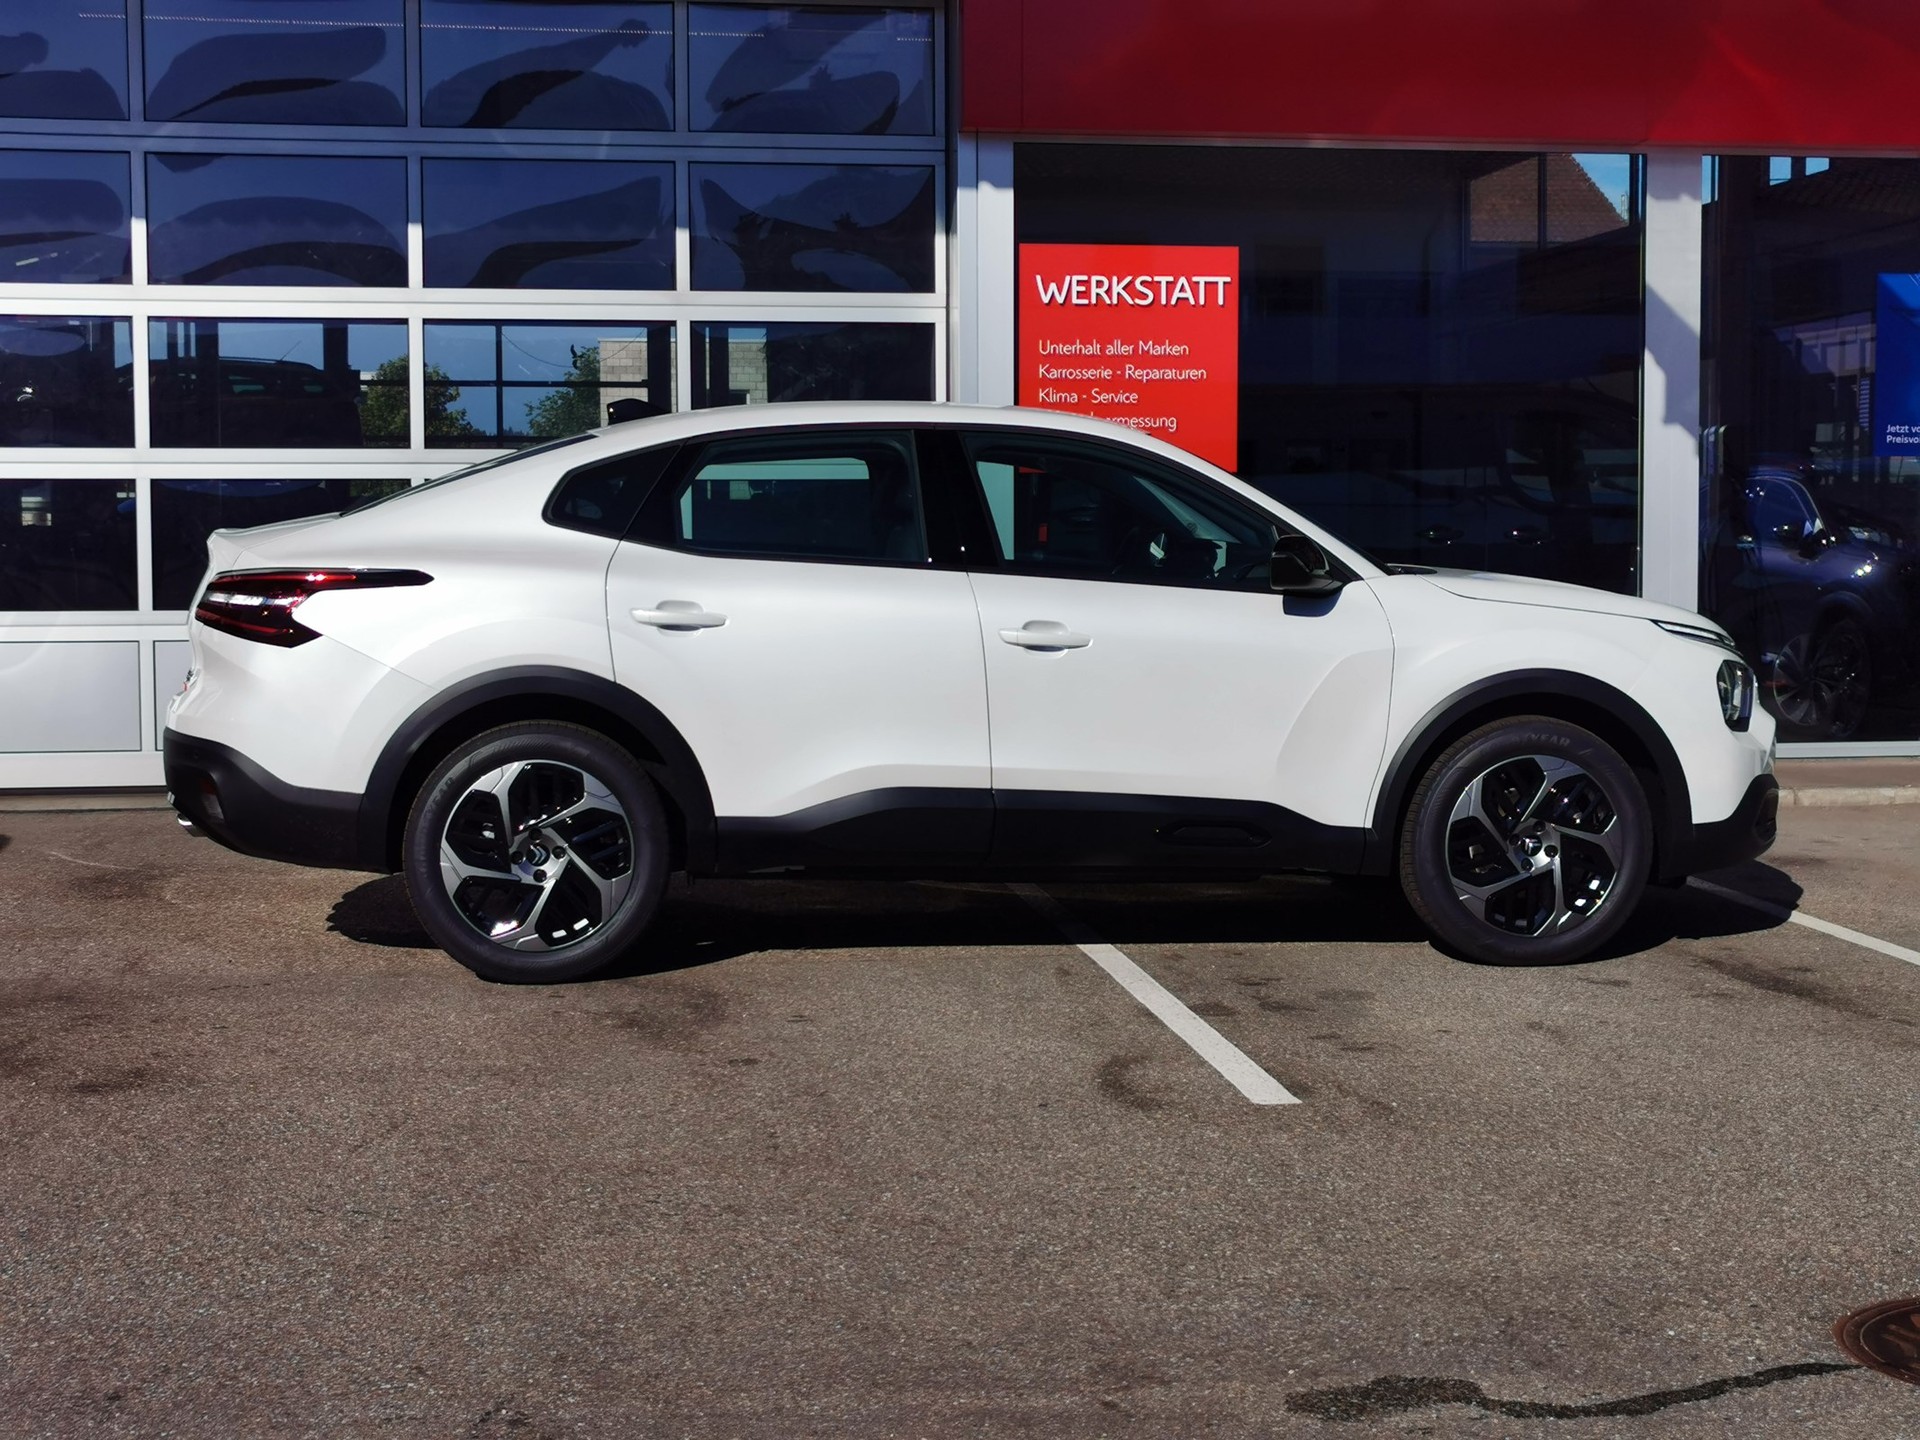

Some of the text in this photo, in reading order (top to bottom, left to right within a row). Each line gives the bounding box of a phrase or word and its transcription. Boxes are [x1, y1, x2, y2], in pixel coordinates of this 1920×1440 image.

[1035, 274, 1232, 306] WERKSTATT
[1038, 339, 1189, 356] Unterhalt aller Marken
[1038, 364, 1113, 380] Karrosserie
[1125, 364, 1207, 383] Reparaturen
[1038, 388, 1079, 404] Klima
[1091, 388, 1139, 404] Service
[1886, 424, 1909, 433] Jetzt
[1886, 434, 1920, 444] Preisvo
